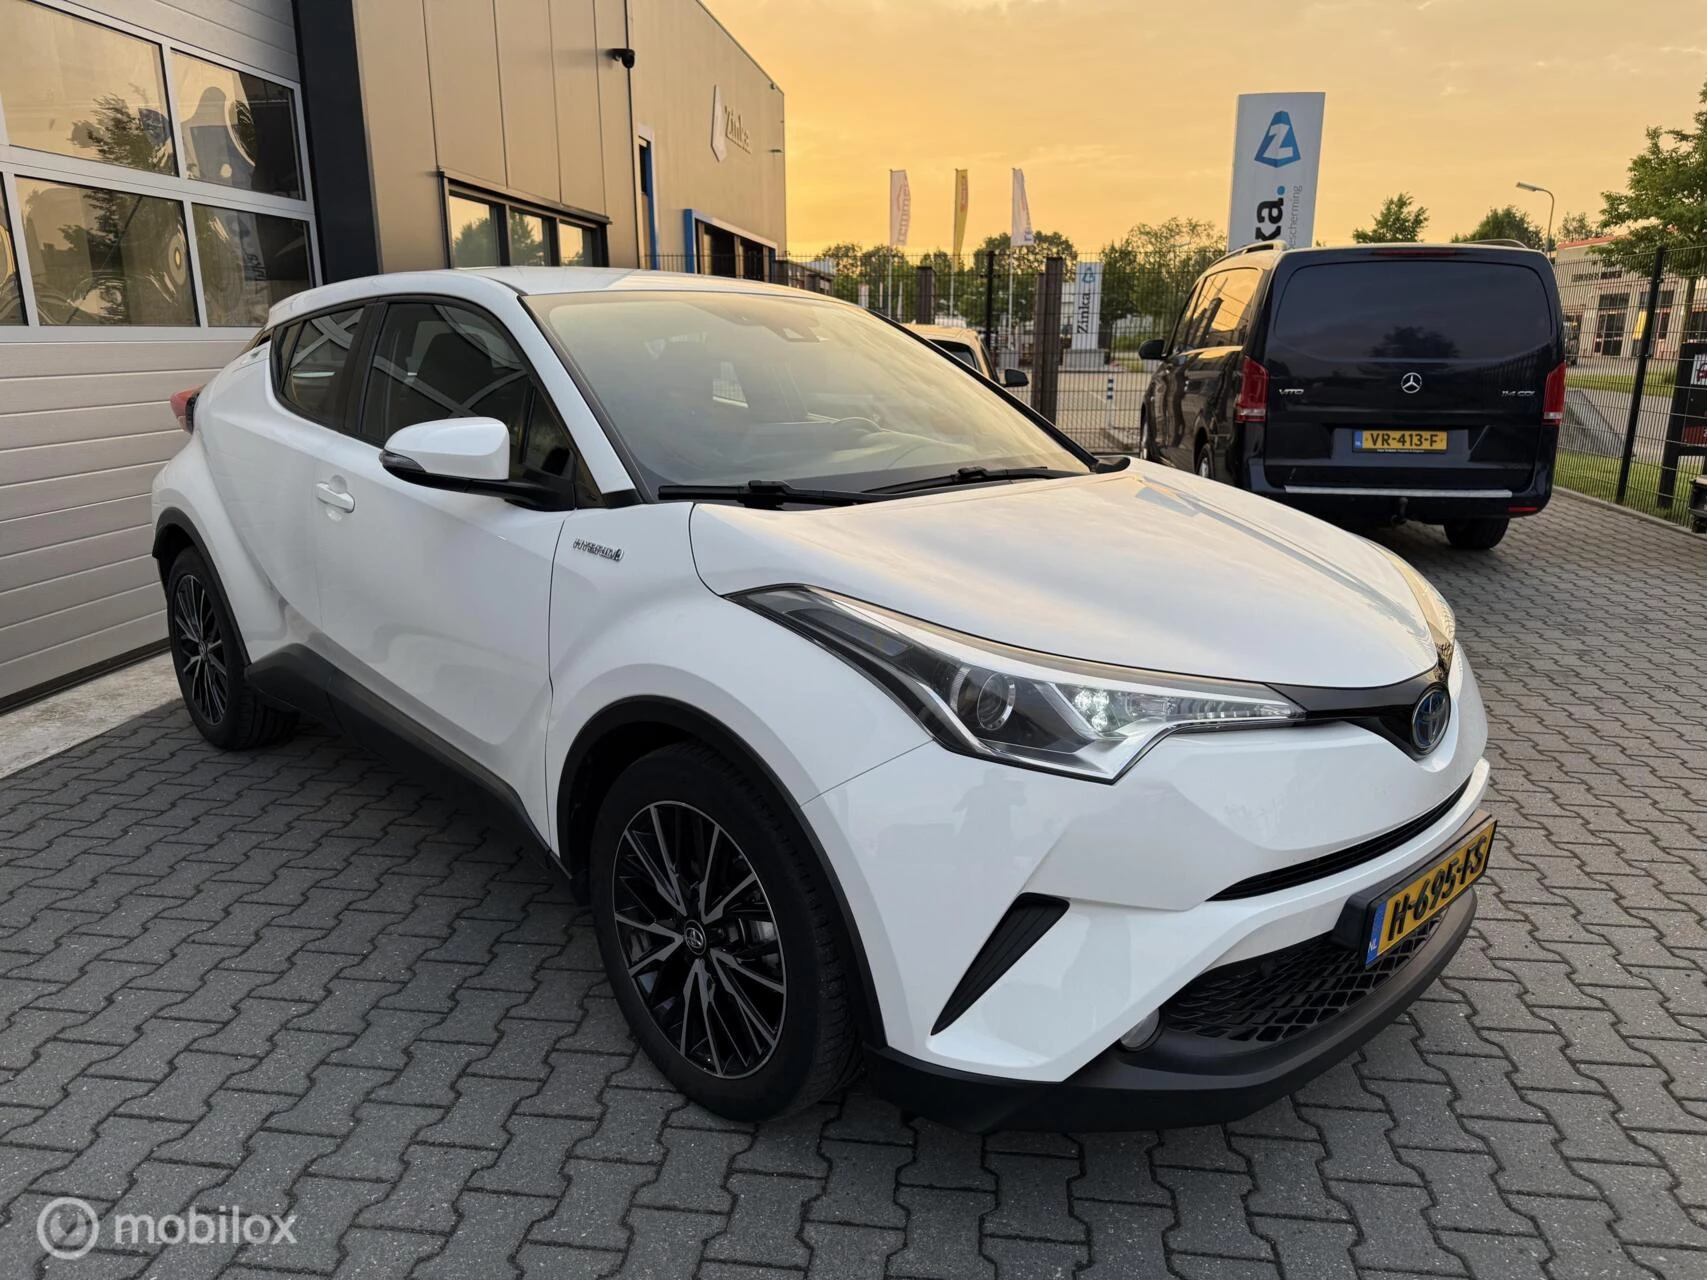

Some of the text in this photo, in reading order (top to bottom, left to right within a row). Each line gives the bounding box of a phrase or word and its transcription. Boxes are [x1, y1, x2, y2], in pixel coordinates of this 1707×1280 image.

[1287, 185, 1303, 249] escherming
[1370, 432, 1439, 448] VR-413-F
[1367, 834, 1488, 953] NL H-695-FS
